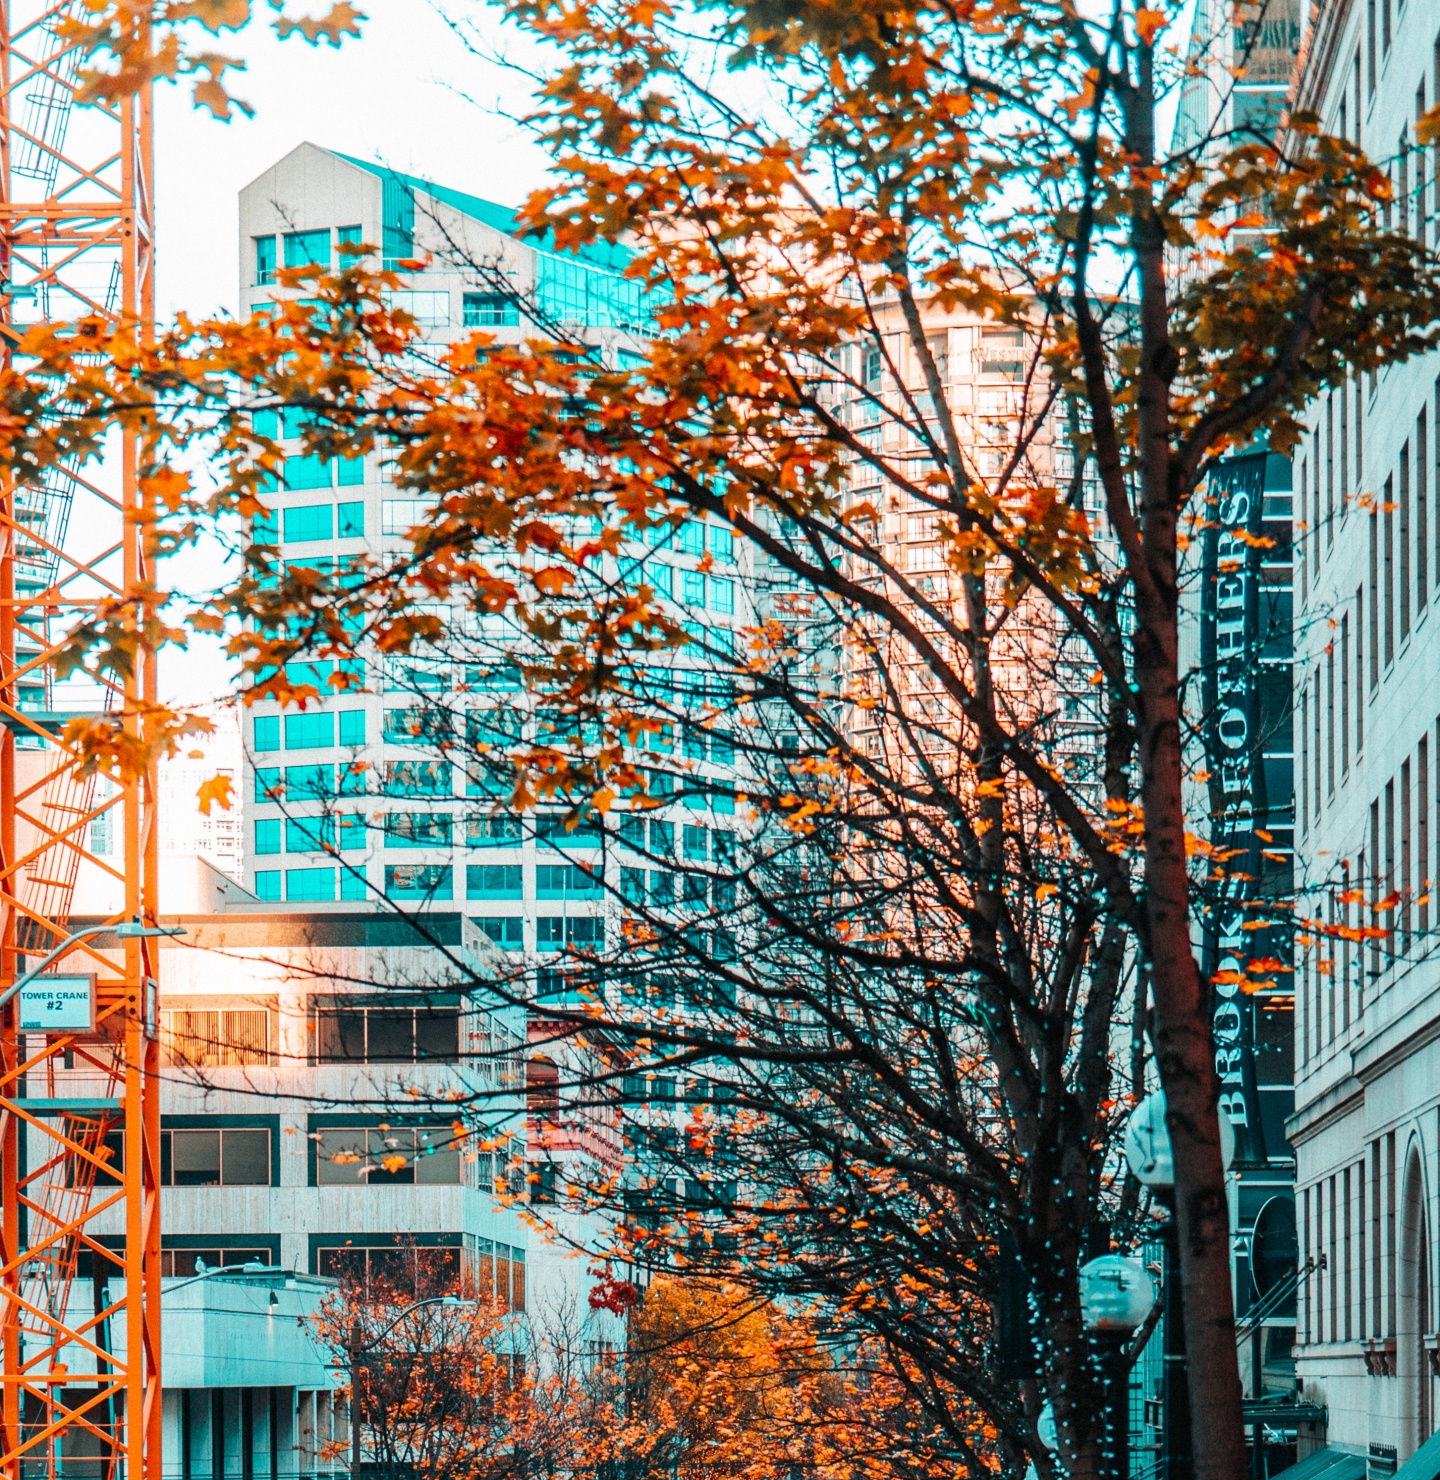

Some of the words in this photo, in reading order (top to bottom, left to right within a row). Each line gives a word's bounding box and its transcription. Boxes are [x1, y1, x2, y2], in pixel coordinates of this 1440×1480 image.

[1215, 491, 1253, 837] BROTHERS
[21, 992, 54, 1000] TOWER
[56, 992, 88, 1000] CRANE
[46, 1000, 63, 1011] #2
